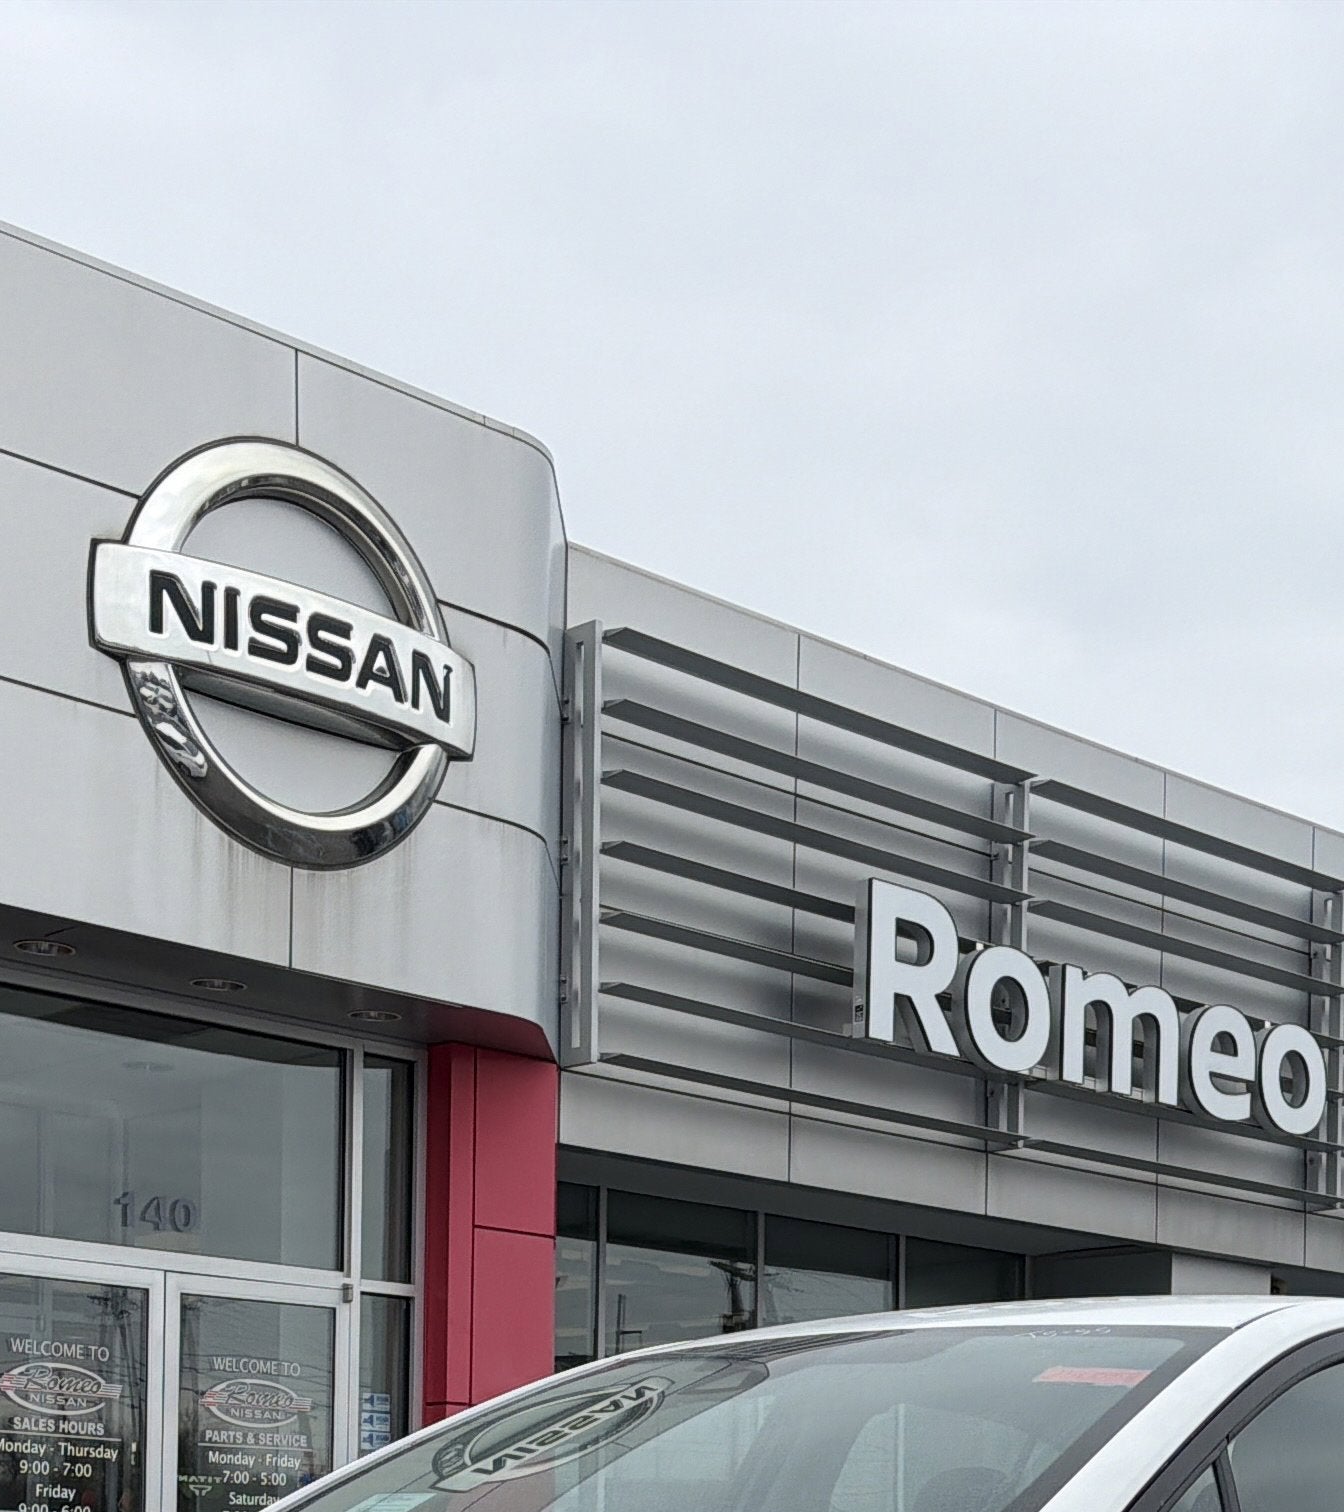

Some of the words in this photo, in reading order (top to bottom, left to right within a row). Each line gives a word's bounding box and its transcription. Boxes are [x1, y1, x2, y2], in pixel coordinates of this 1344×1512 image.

[148, 568, 454, 725] NISSAN
[866, 876, 1328, 1136] Romeo
[113, 1191, 197, 1233] 140
[10, 1337, 85, 1360] WELCOME
[88, 1345, 110, 1362] TO
[212, 1356, 280, 1375] WELCOME
[282, 1361, 301, 1377] TO
[23, 1364, 102, 1395] Romeo
[29, 1392, 88, 1408] NISSAN
[224, 1381, 295, 1408] Romeo
[230, 1407, 282, 1420] NISSAN
[13, 1416, 56, 1432] SALES
[58, 1420, 105, 1436] HOURS
[204, 1429, 243, 1445] PARTS
[246, 1432, 256, 1445] &
[258, 1432, 308, 1447] SERVICE
[57, 1441, 119, 1463] Thursday
[208, 1450, 256, 1468] Monday
[265, 1453, 301, 1471] Friday
[19, 1459, 50, 1475] 9:00
[62, 1462, 93, 1478] 7:00
[222, 1470, 250, 1484] 7:00
[260, 1472, 287, 1486] 5:00
[35, 1483, 76, 1502] Friday
